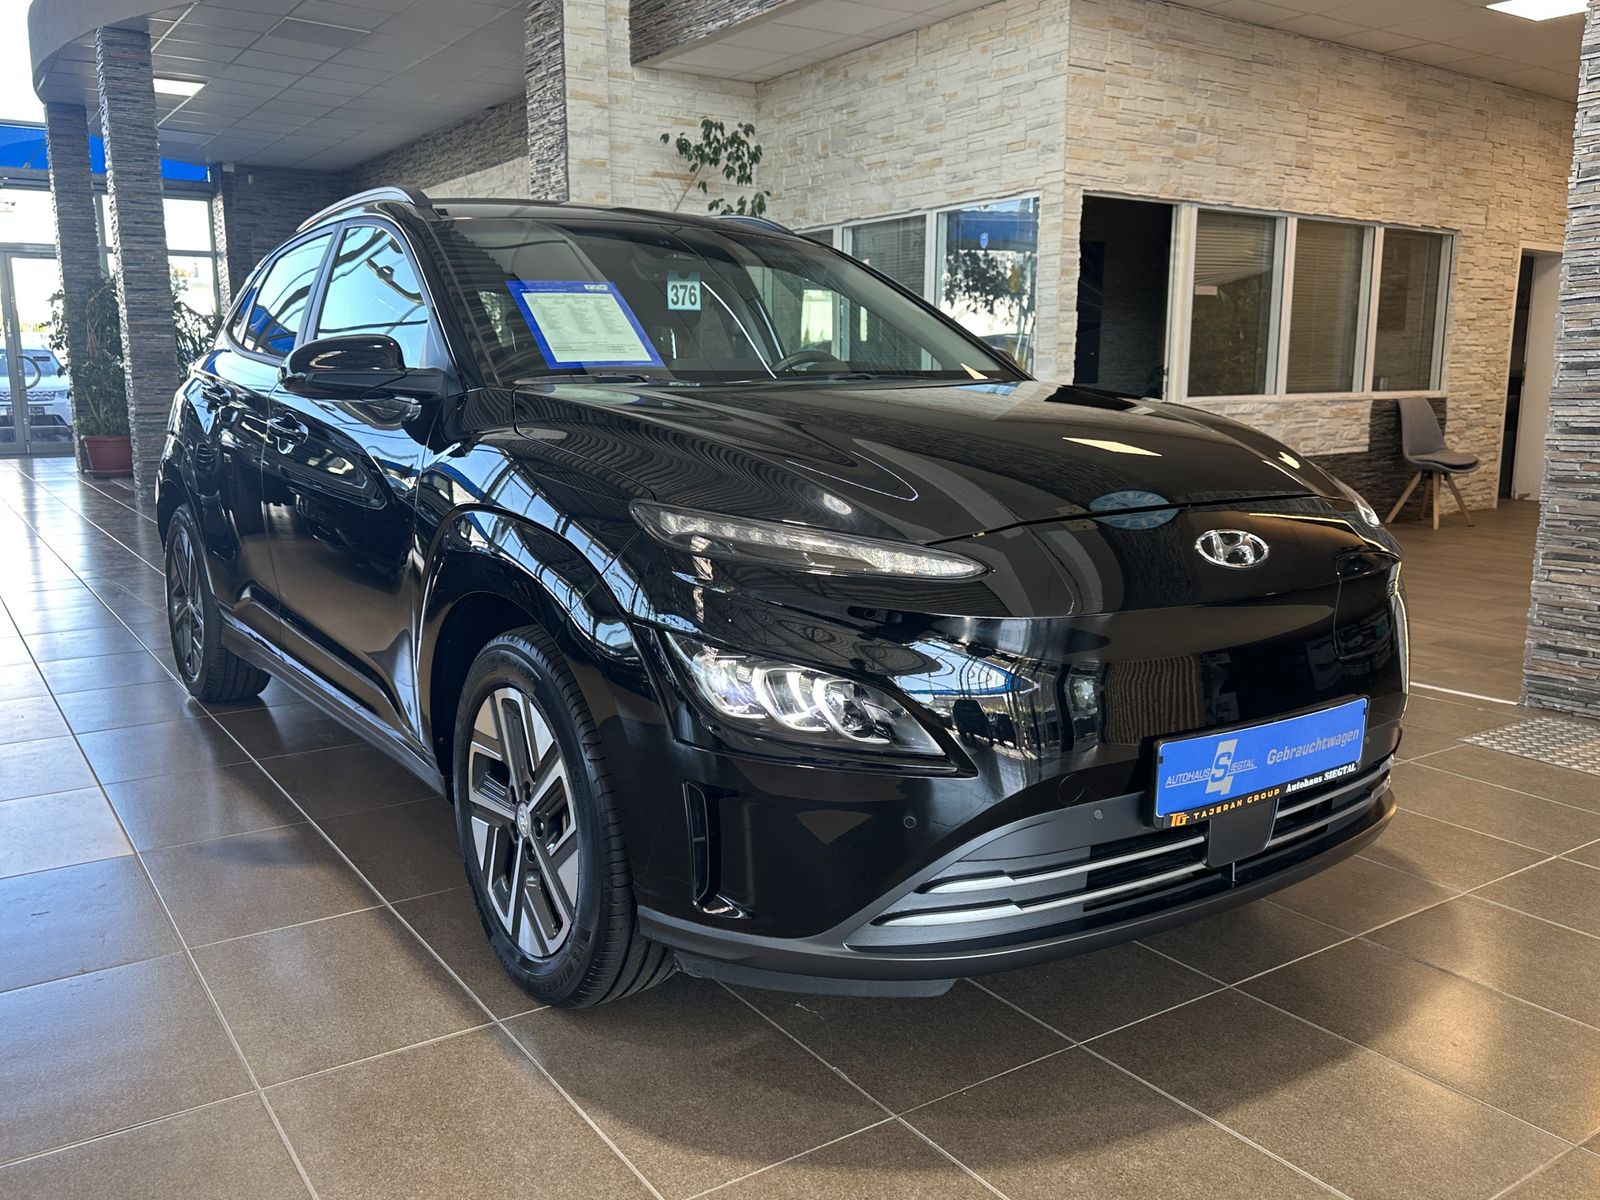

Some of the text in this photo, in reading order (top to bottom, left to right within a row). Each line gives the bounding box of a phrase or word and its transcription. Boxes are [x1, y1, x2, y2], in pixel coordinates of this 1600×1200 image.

[670, 284, 698, 306] 376
[1266, 728, 1360, 765] Gebrauchtwagen
[1165, 767, 1212, 786] AUTOHAUS
[1285, 763, 1357, 794] Autohaus SIEGTAL
[1193, 799, 1243, 820] TAJERAN
[1247, 788, 1281, 804] GROUP
[529, 959, 574, 992] MICHEL
